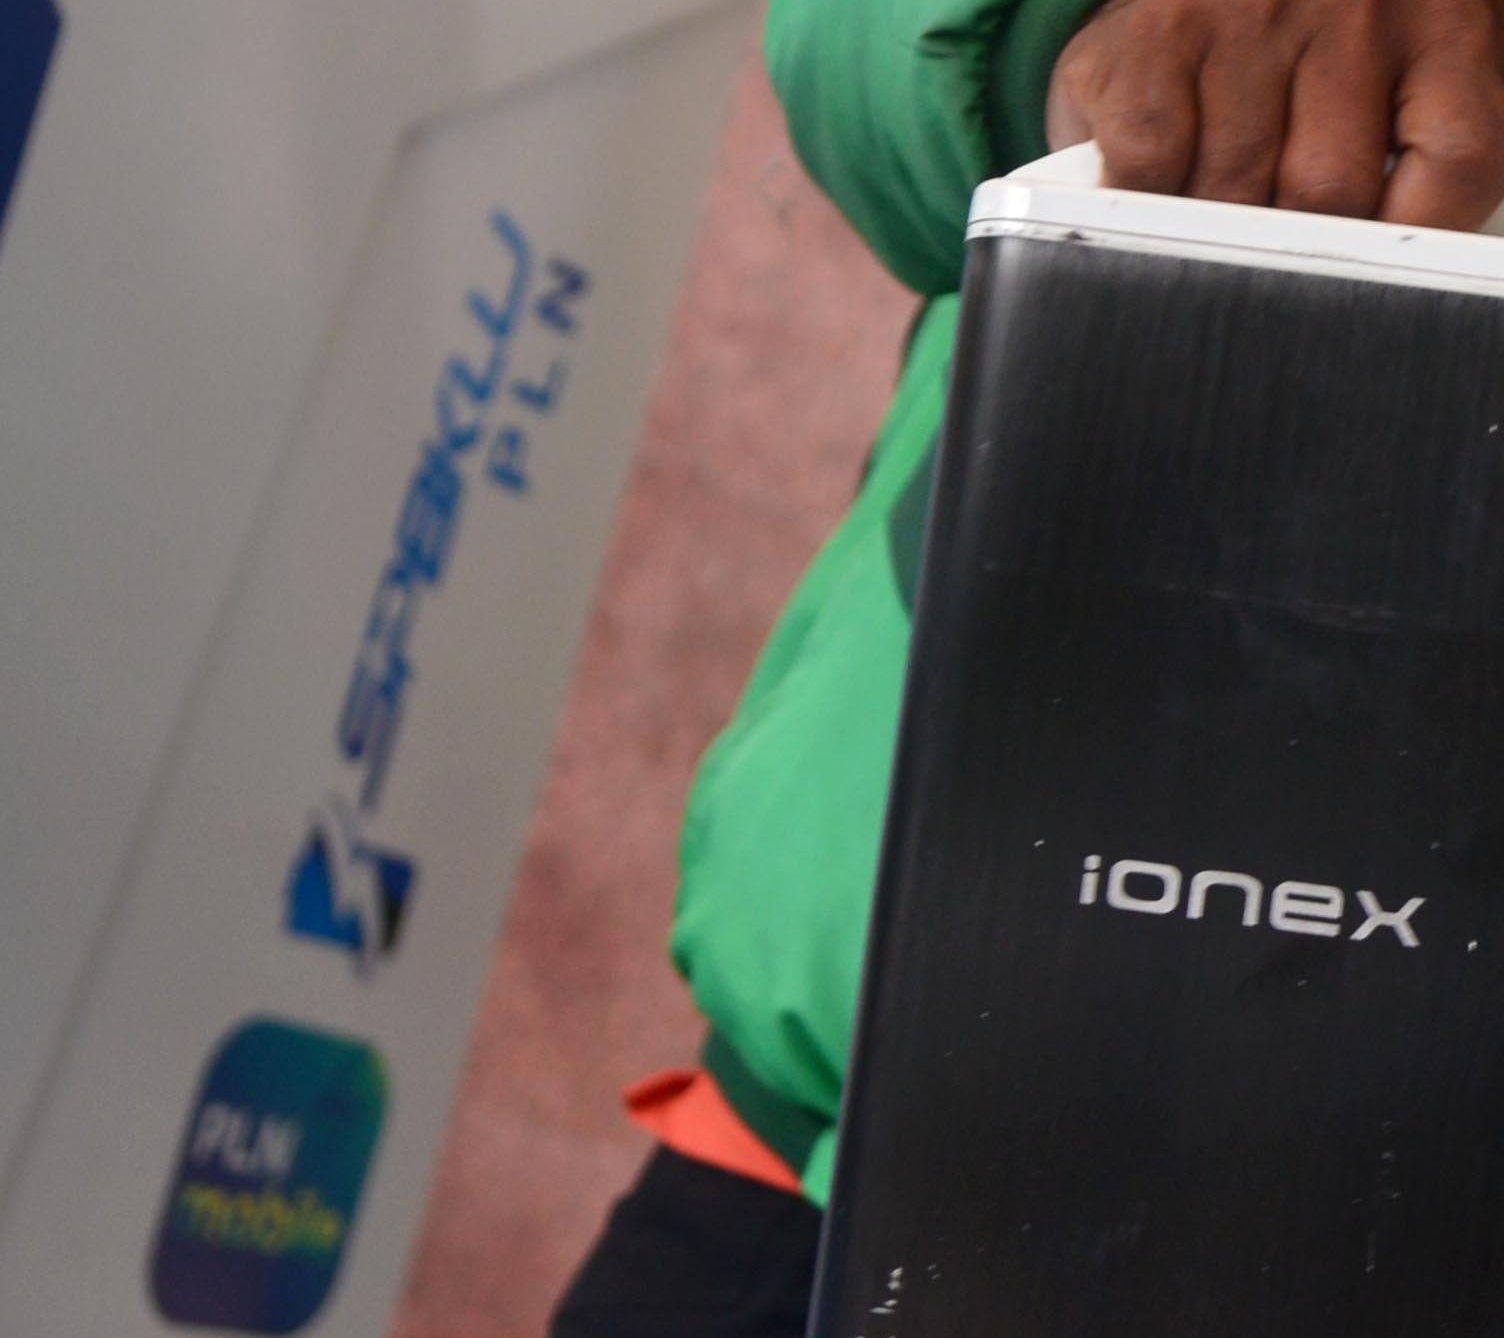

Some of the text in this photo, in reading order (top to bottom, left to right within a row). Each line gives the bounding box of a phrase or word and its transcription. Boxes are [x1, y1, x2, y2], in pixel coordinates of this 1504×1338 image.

[486, 253, 588, 495] PLN
[1078, 854, 1427, 948] ionex
[193, 1102, 302, 1178] PLN
